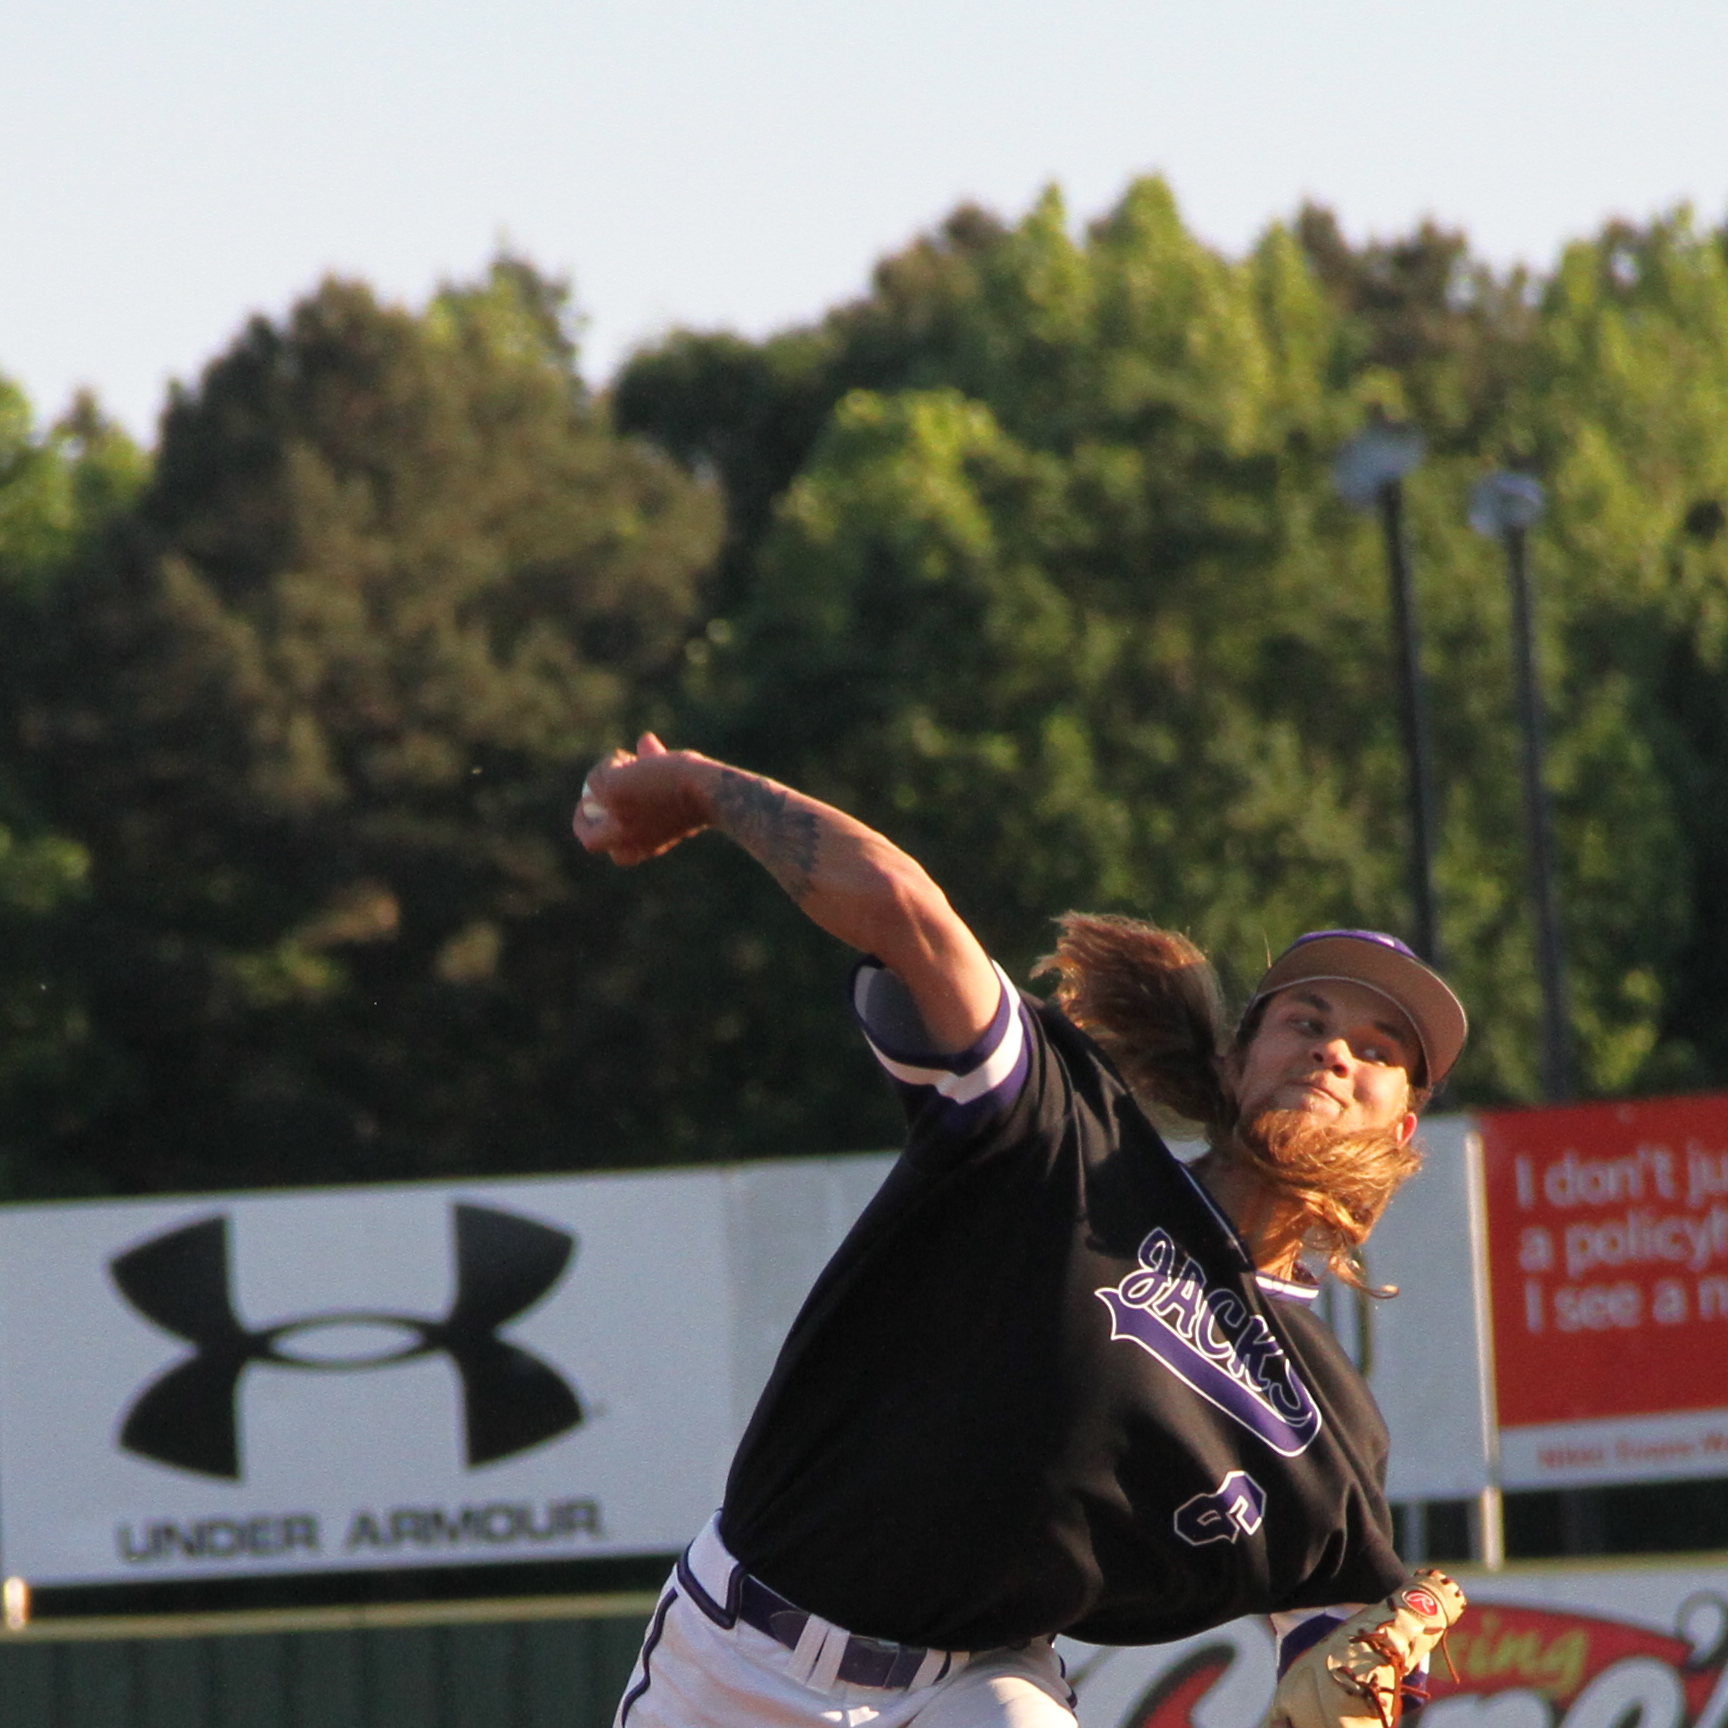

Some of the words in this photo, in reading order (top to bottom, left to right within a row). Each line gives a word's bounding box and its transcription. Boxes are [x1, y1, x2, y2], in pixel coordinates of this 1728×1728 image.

[1515, 1151, 1534, 1209] I
[1545, 1145, 1675, 1207] don't
[1519, 1226, 1554, 1272] a
[1118, 1227, 1322, 1428] JACKS
[1524, 1279, 1543, 1334] I
[1554, 1280, 1642, 1332] see
[1652, 1279, 1688, 1324] a
[116, 1511, 322, 1562] UNDER
[346, 1499, 606, 1548] ARMOUR
